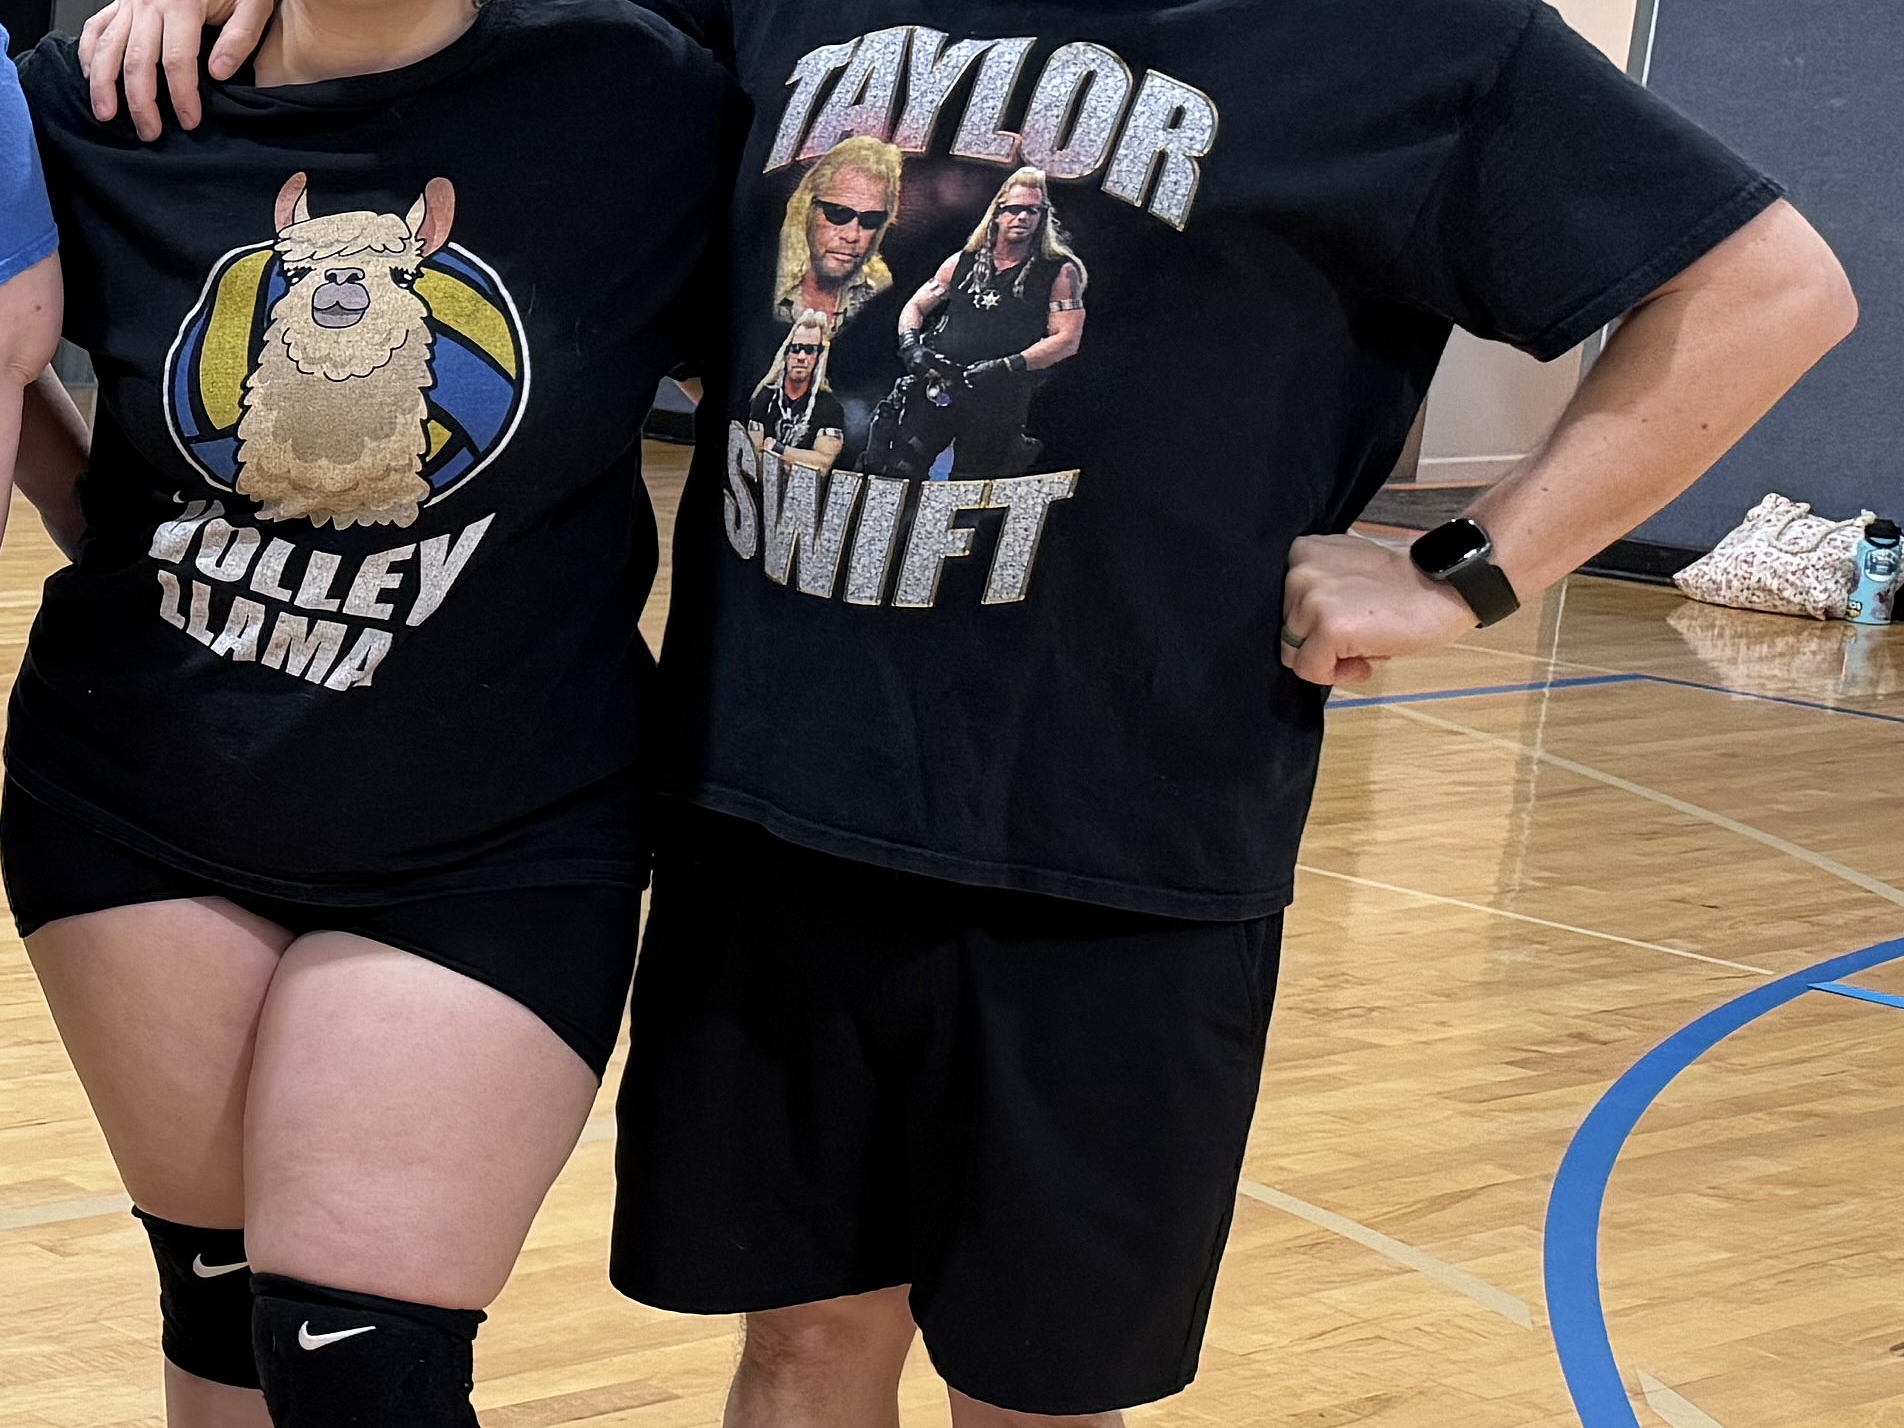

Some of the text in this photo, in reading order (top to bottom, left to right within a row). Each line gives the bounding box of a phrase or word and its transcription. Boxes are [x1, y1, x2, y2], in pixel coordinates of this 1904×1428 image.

[762, 25, 1220, 232] TAYLOR
[148, 490, 496, 627] VOLLEY
[723, 420, 1081, 608] SWIFT
[158, 569, 394, 691] LLAMA
